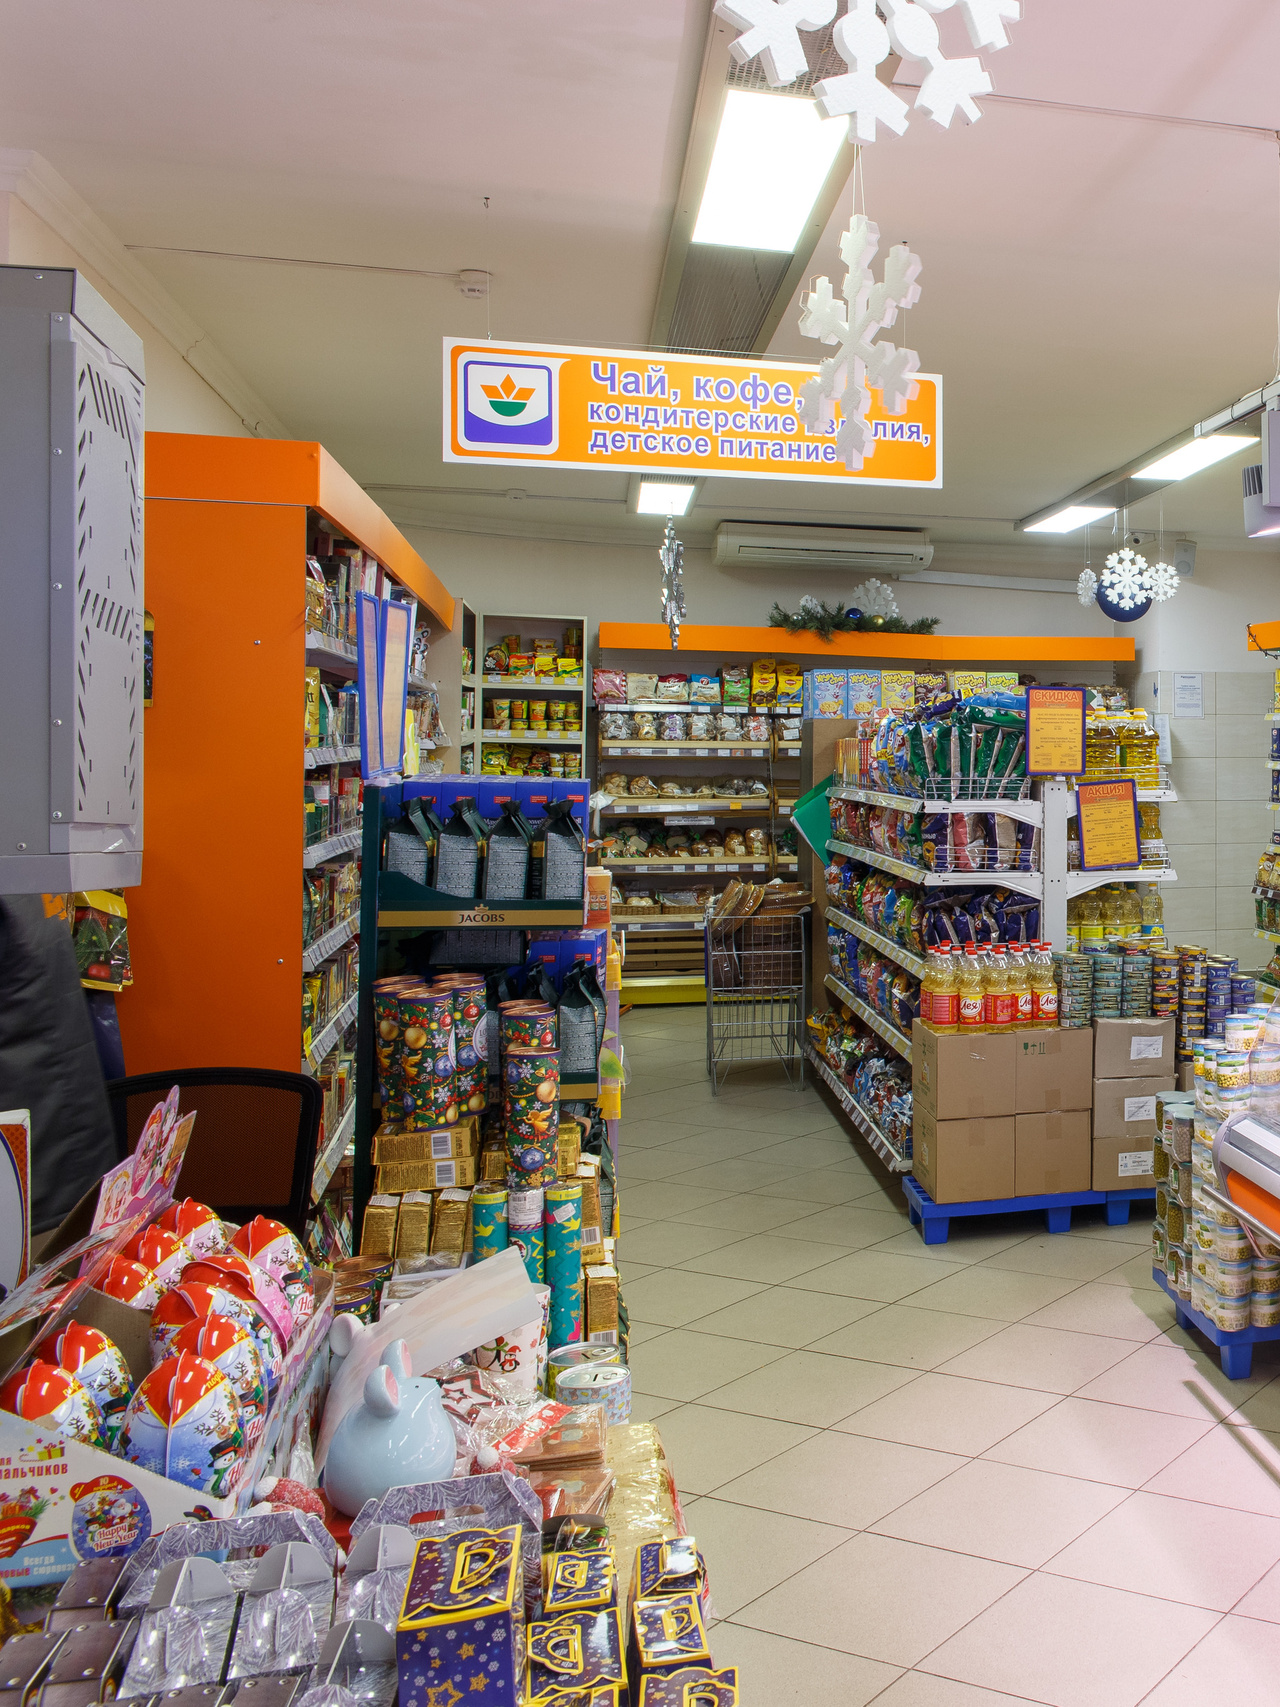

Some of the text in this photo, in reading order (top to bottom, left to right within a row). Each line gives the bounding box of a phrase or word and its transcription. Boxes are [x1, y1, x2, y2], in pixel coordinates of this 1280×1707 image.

[591, 361, 805, 411] Чай, кофе,
[588, 402, 931, 446] кондитерские злия,
[588, 430, 838, 462] детское питание
[1034, 691, 1079, 701] СКИДКА
[1087, 784, 1125, 797] АКЦИЯ
[458, 914, 505, 924] JACOBS
[961, 1000, 979, 1011] Лея
[1020, 997, 1032, 1007] Ле
[98, 1524, 128, 1541] Happy
[116, 1530, 138, 1546] Year
